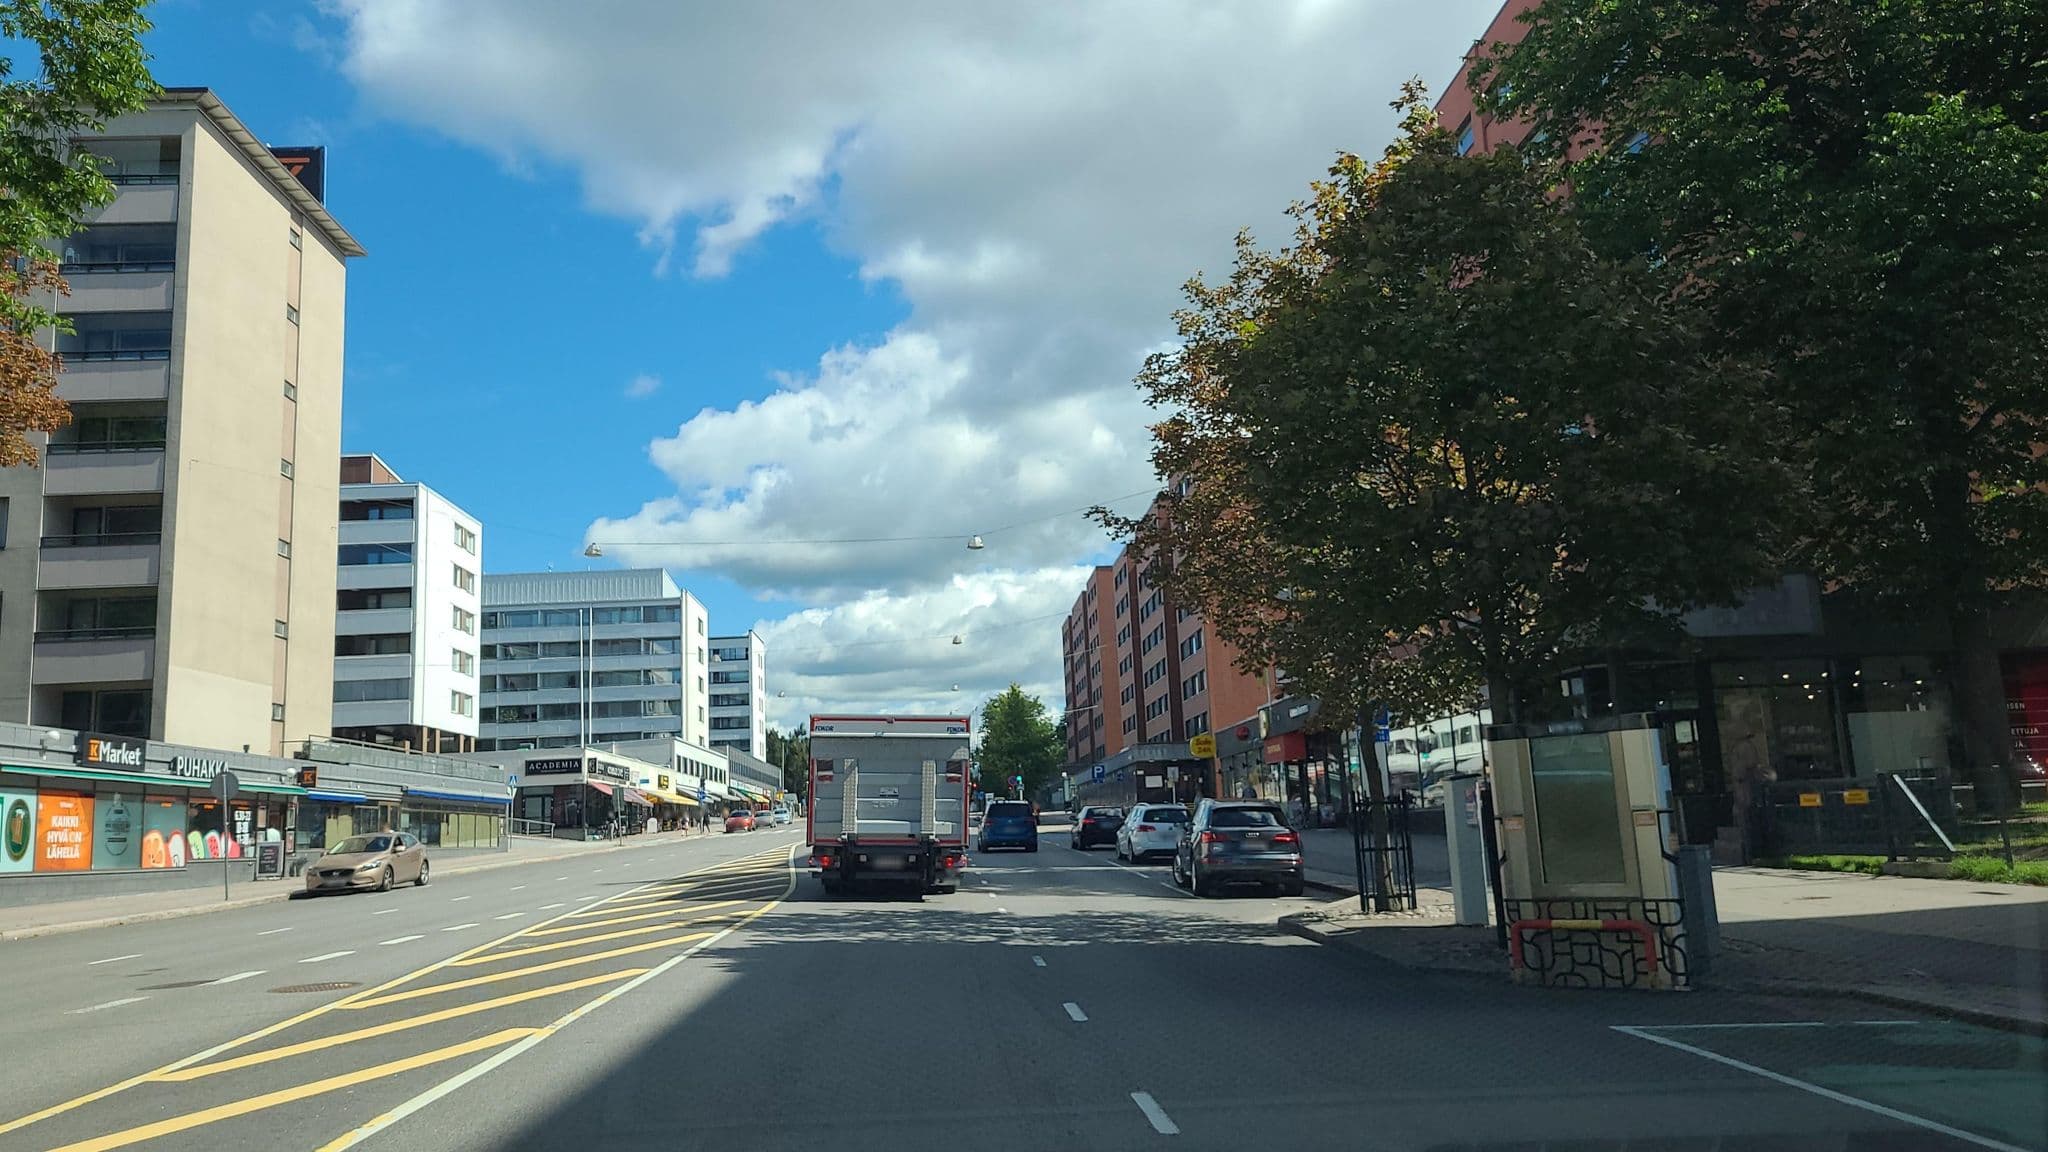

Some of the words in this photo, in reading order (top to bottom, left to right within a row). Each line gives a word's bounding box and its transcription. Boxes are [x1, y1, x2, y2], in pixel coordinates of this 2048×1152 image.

[100, 740, 141, 766] Market
[529, 760, 580, 770] ACADEMIA
[51, 815, 79, 828] KAIKKI
[46, 829, 69, 843] HYVÄ
[69, 831, 82, 843] ON
[46, 844, 80, 859] LÄHELLÄ
